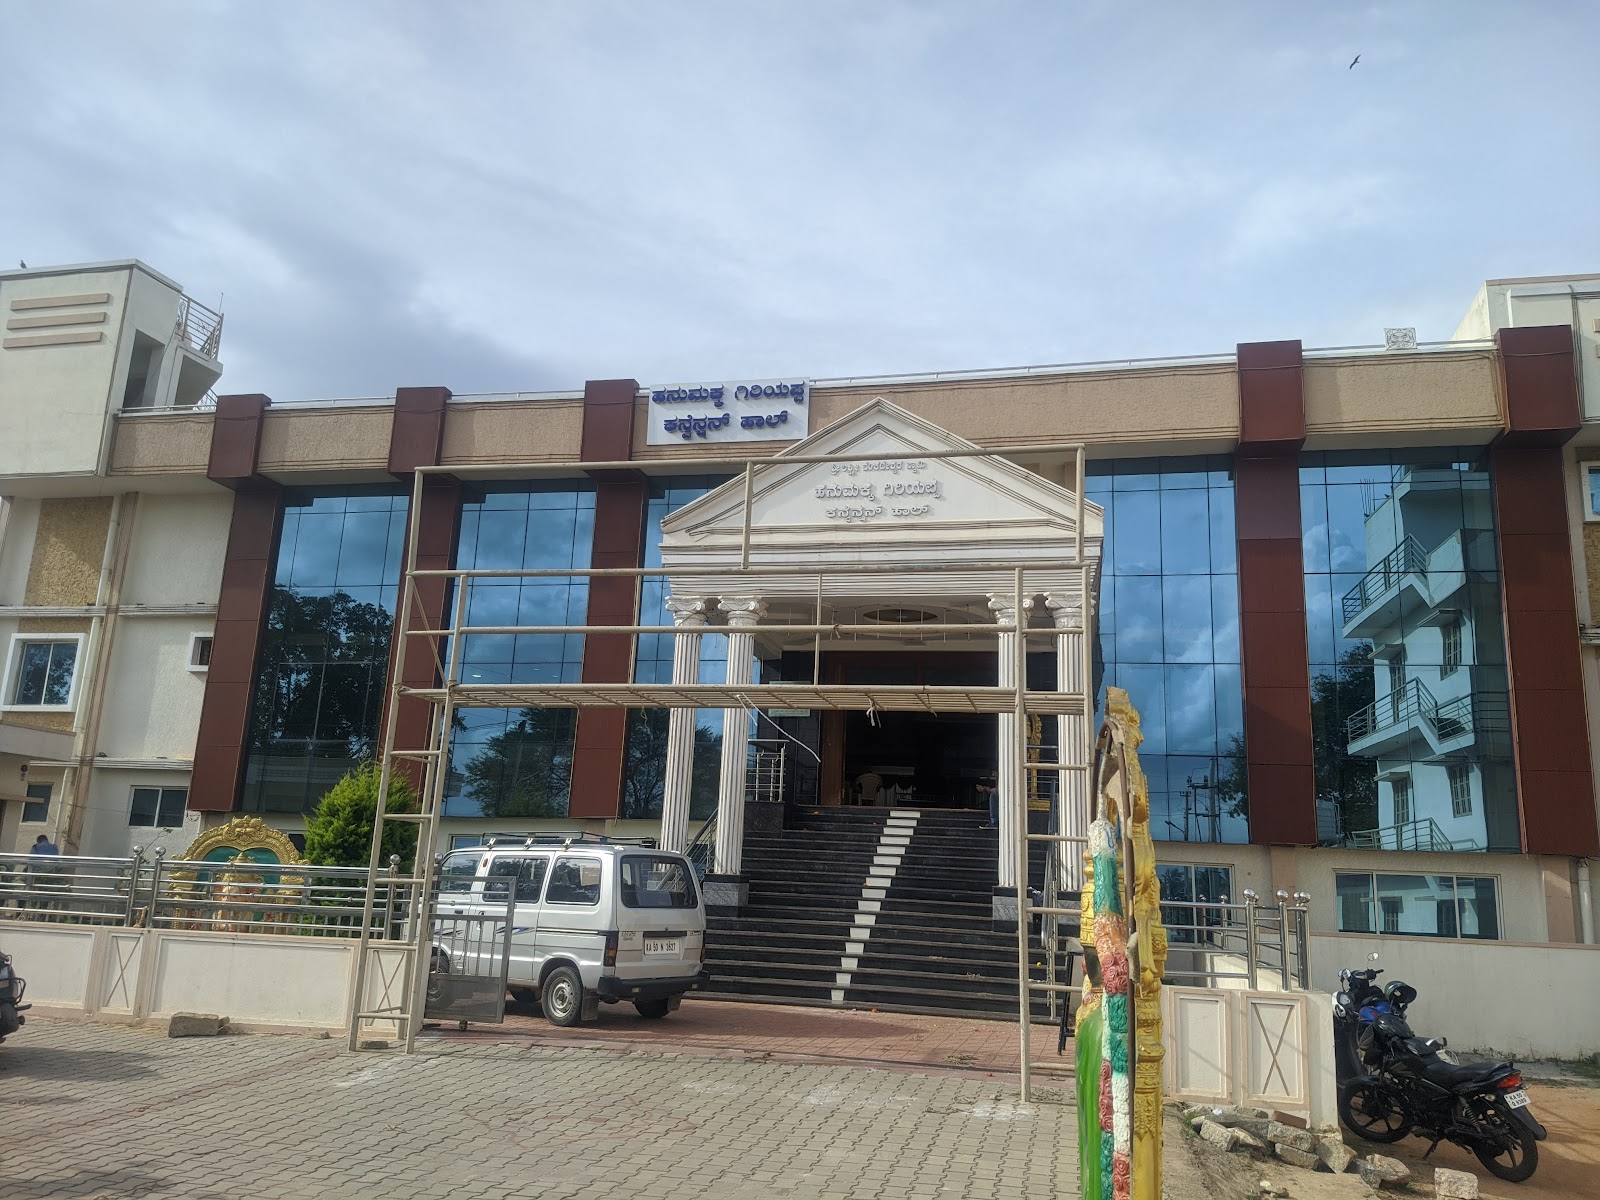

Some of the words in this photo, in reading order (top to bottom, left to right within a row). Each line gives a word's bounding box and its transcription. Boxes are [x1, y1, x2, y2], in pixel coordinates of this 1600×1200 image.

[652, 384, 725, 409] ಹನುಮಕ್ಕ
[734, 379, 806, 404] ಗಿರಿಯಪ್ಪ
[740, 410, 789, 429] ಹಾಲ್
[814, 482, 876, 501] ಹನುಮಕ್ಕ
[883, 479, 941, 498] ಗಿರಿಯಪ್ಪ
[891, 503, 929, 516] ಹಾಲ್
